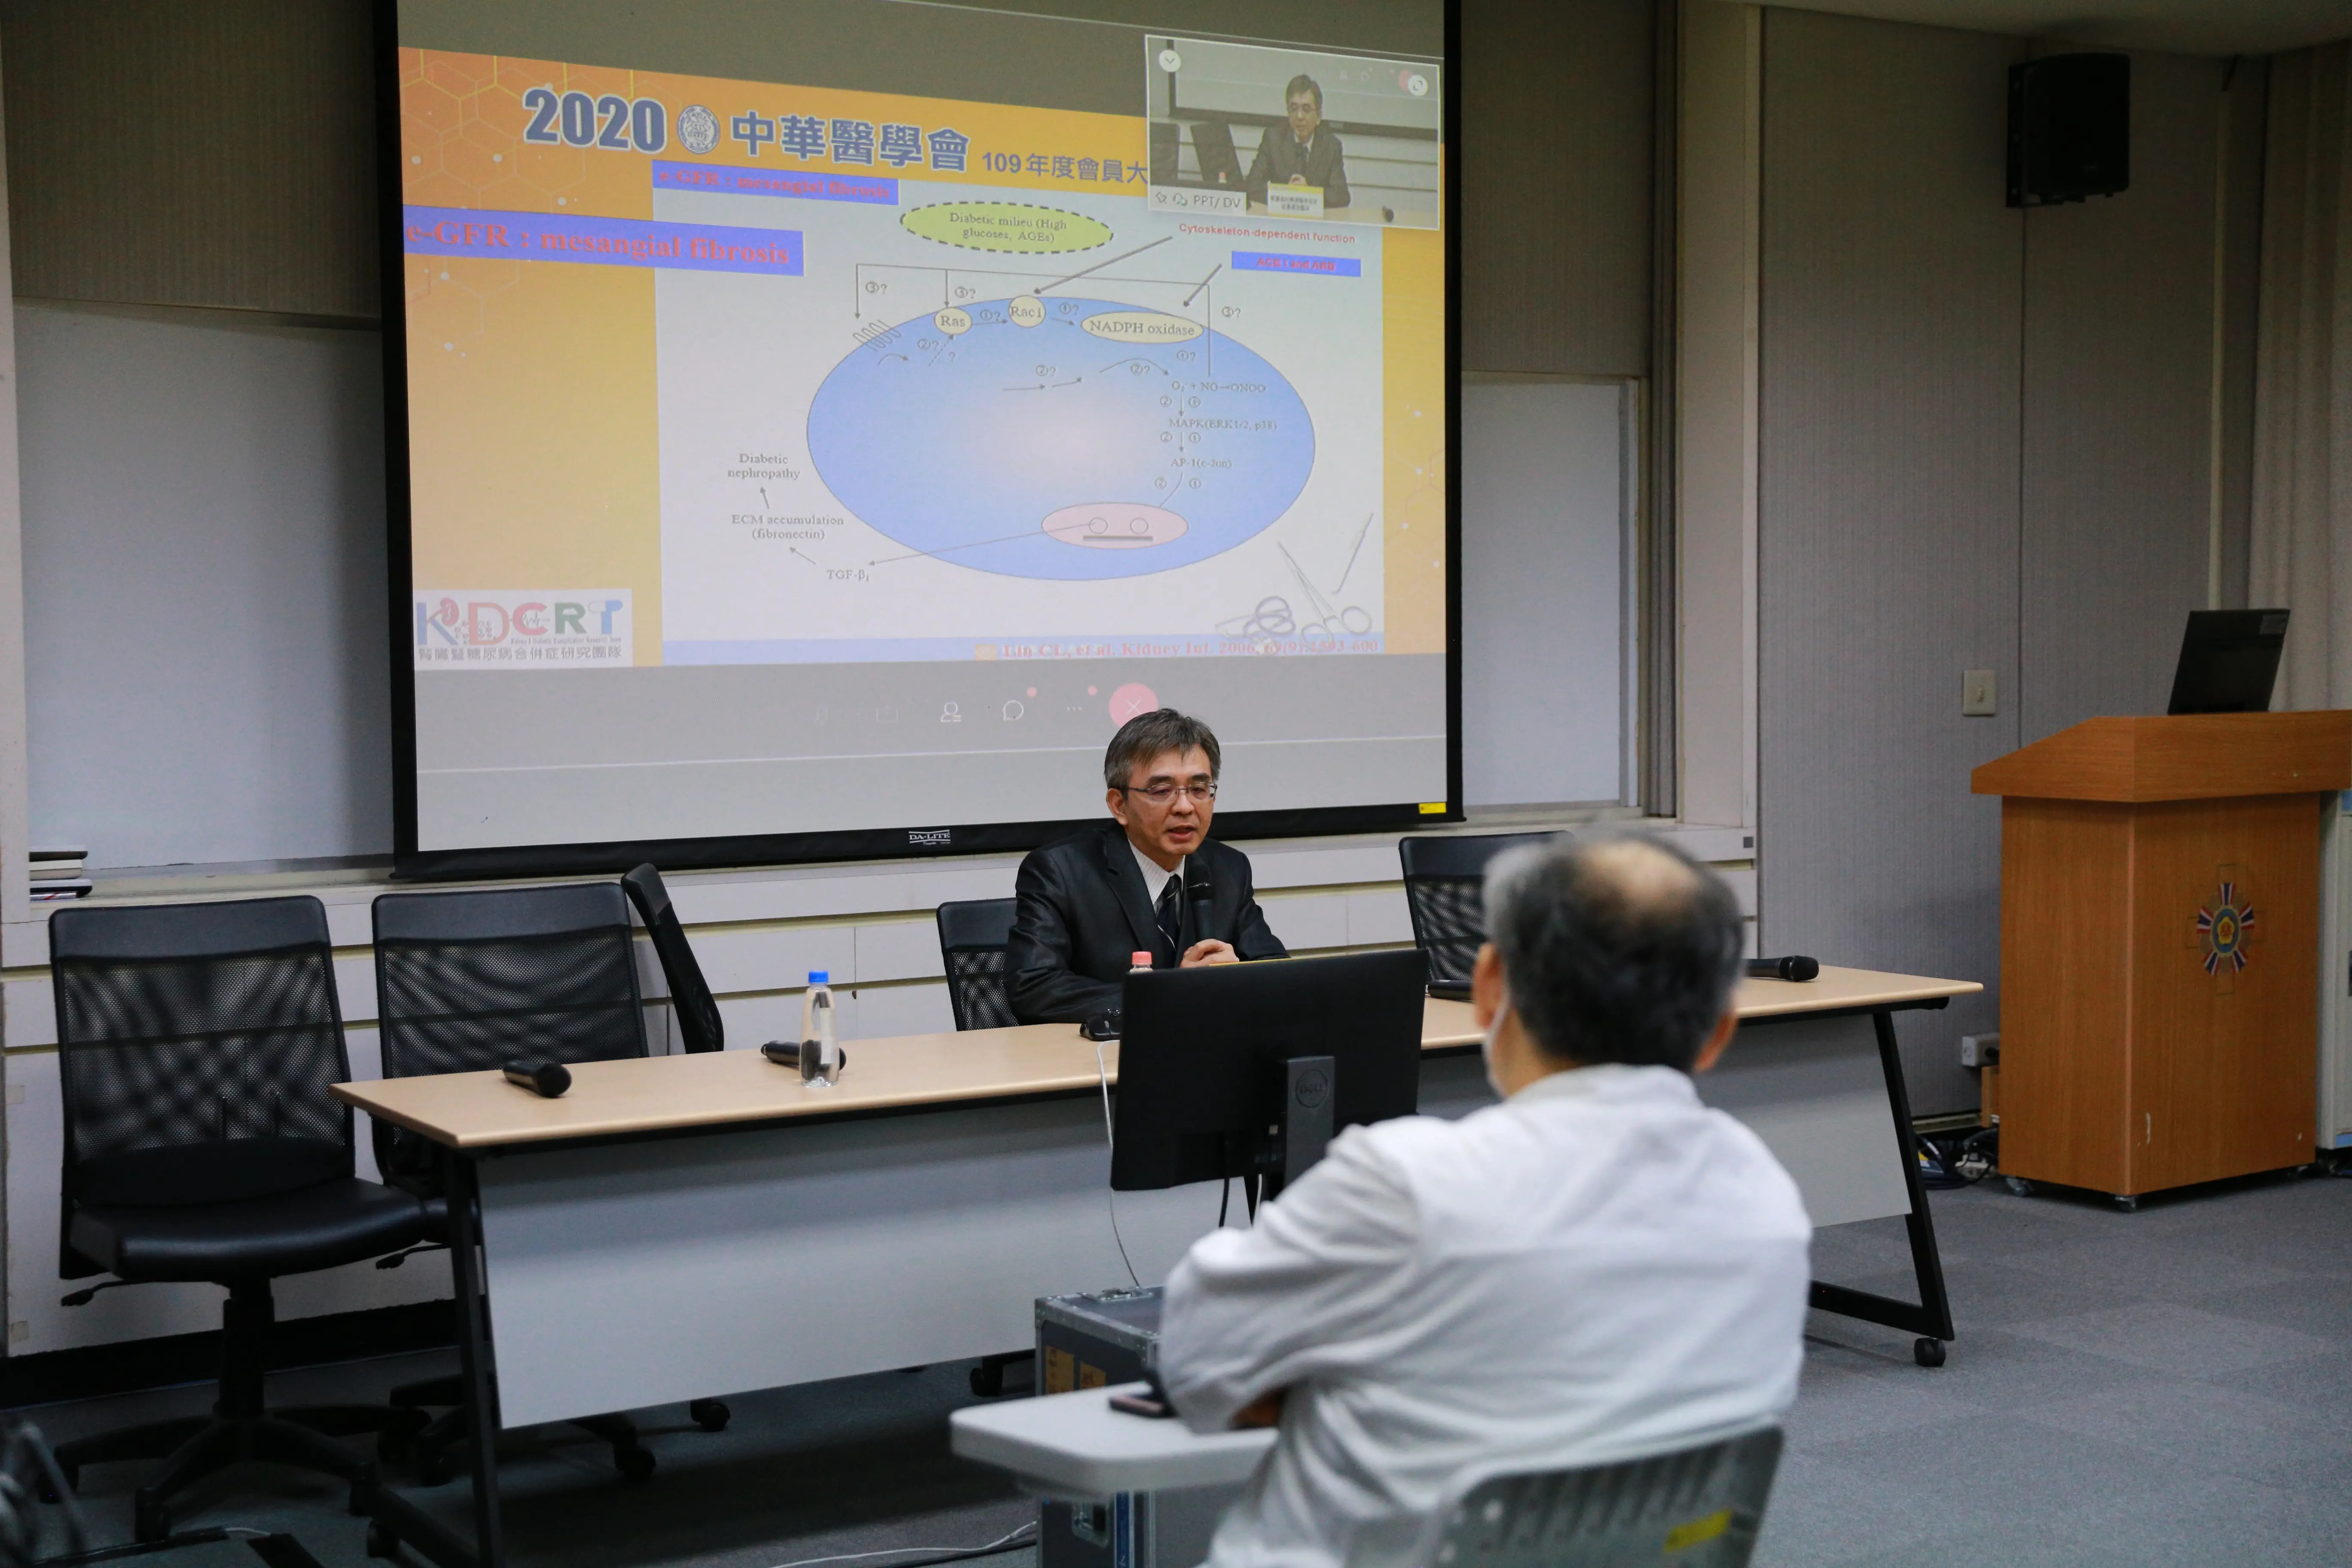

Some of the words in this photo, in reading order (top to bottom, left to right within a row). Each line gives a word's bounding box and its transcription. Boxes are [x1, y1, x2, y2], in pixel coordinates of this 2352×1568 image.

[522, 87, 667, 153] 2020
[731, 111, 970, 172] 中華醫學會
[738, 176, 823, 195] mesangial
[829, 183, 889, 198] fibrosis
[950, 213, 994, 225] Diabetic
[999, 217, 1032, 228] milieu
[1036, 218, 1067, 230] (High
[963, 228, 1012, 241] glucoses,
[1018, 232, 1055, 244] AGEs)
[1179, 224, 1310, 240] Cytoskeleton-dependent
[1314, 233, 1355, 244] function
[407, 221, 510, 248] e-GFR
[541, 233, 680, 260] mesangial
[689, 237, 790, 264] fibrosis
[940, 316, 966, 327] Ras
[1089, 320, 1143, 334] NADPH
[1148, 324, 1195, 336] oxidase
[739, 453, 788, 464] Diabetic
[728, 468, 800, 480] nephropathy
[732, 514, 763, 524] ECM
[767, 514, 844, 526] accumulation
[751, 528, 825, 541] (fibronectin)
[1122, 643, 1179, 657] Kidney
